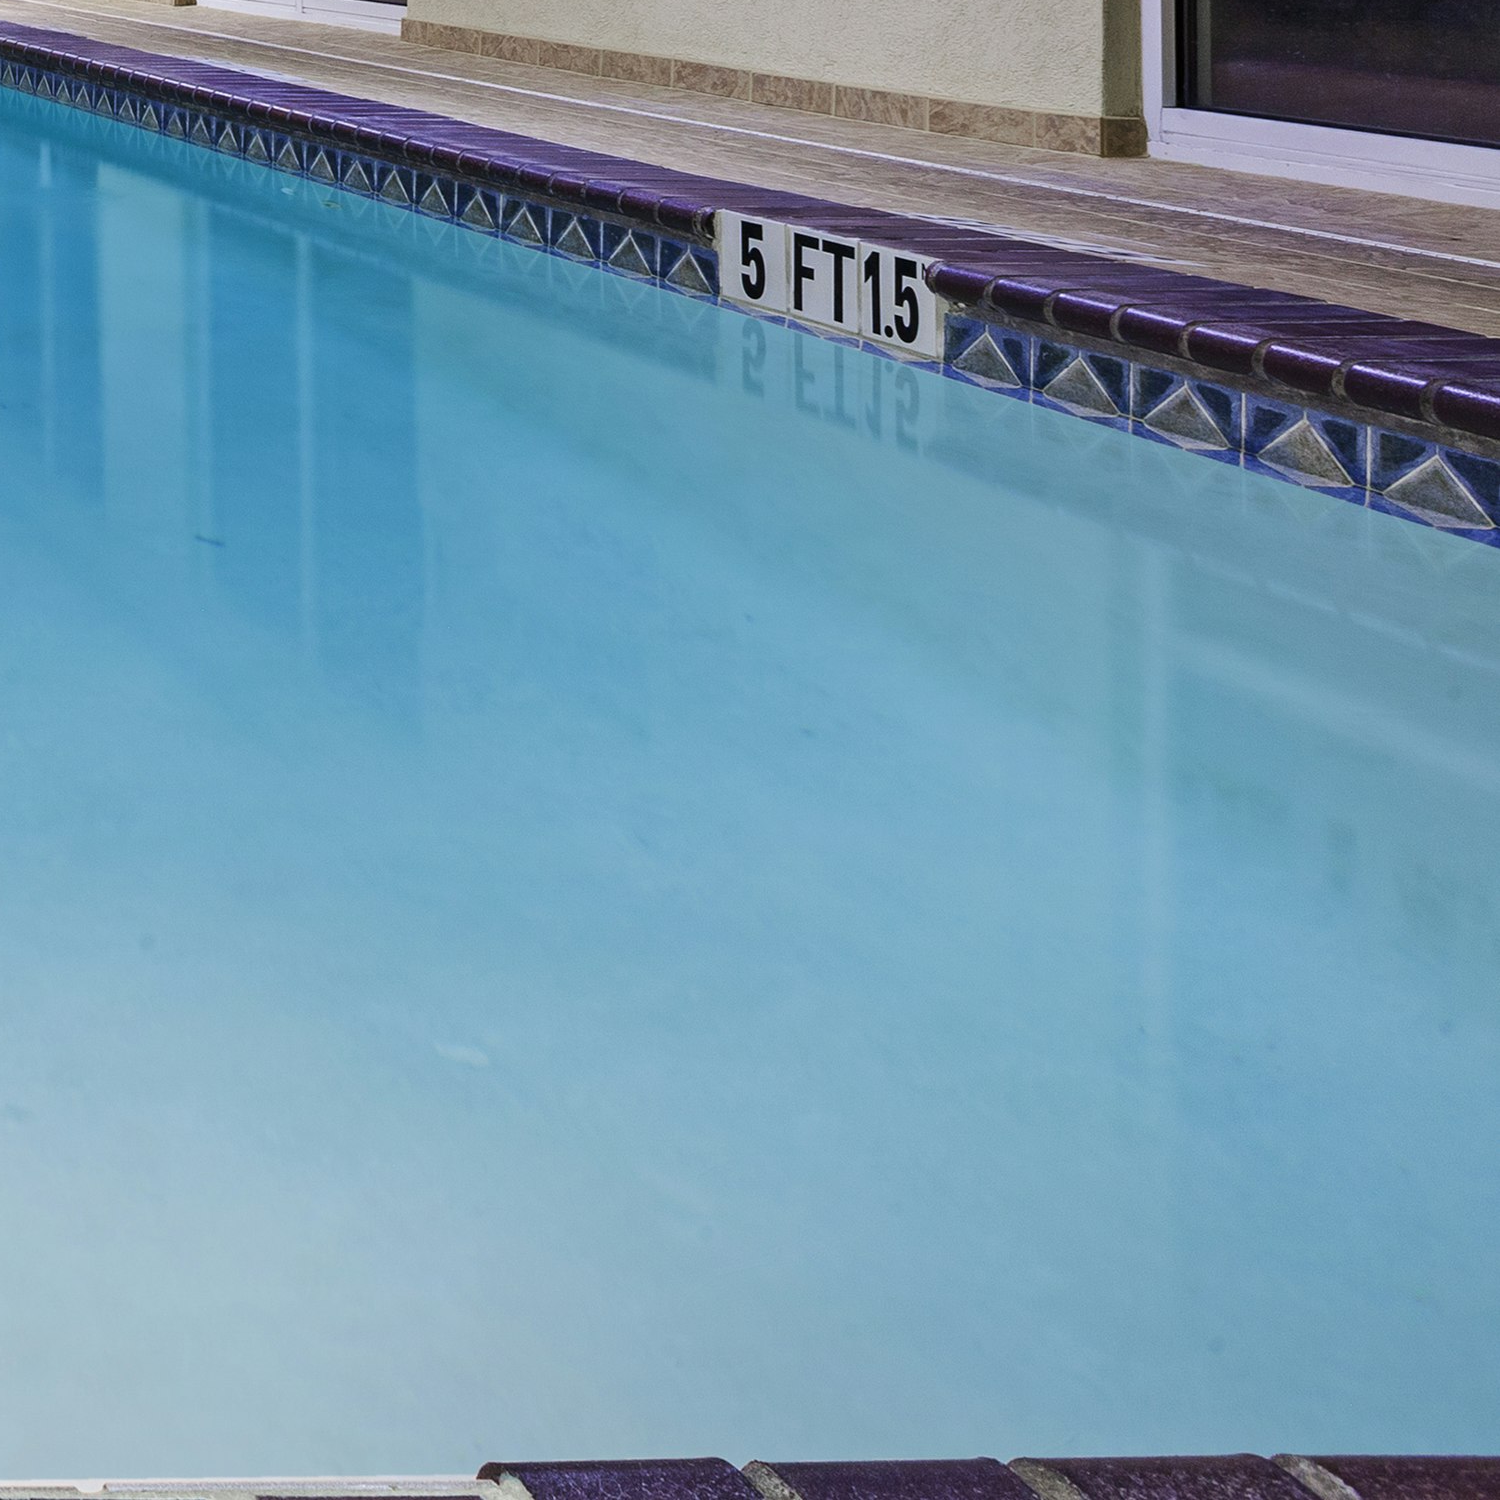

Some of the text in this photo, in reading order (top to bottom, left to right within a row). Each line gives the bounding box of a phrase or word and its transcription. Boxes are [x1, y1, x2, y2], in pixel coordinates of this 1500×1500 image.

[741, 220, 765, 299] 5
[794, 232, 855, 323] FT
[864, 252, 919, 343] 1.5
